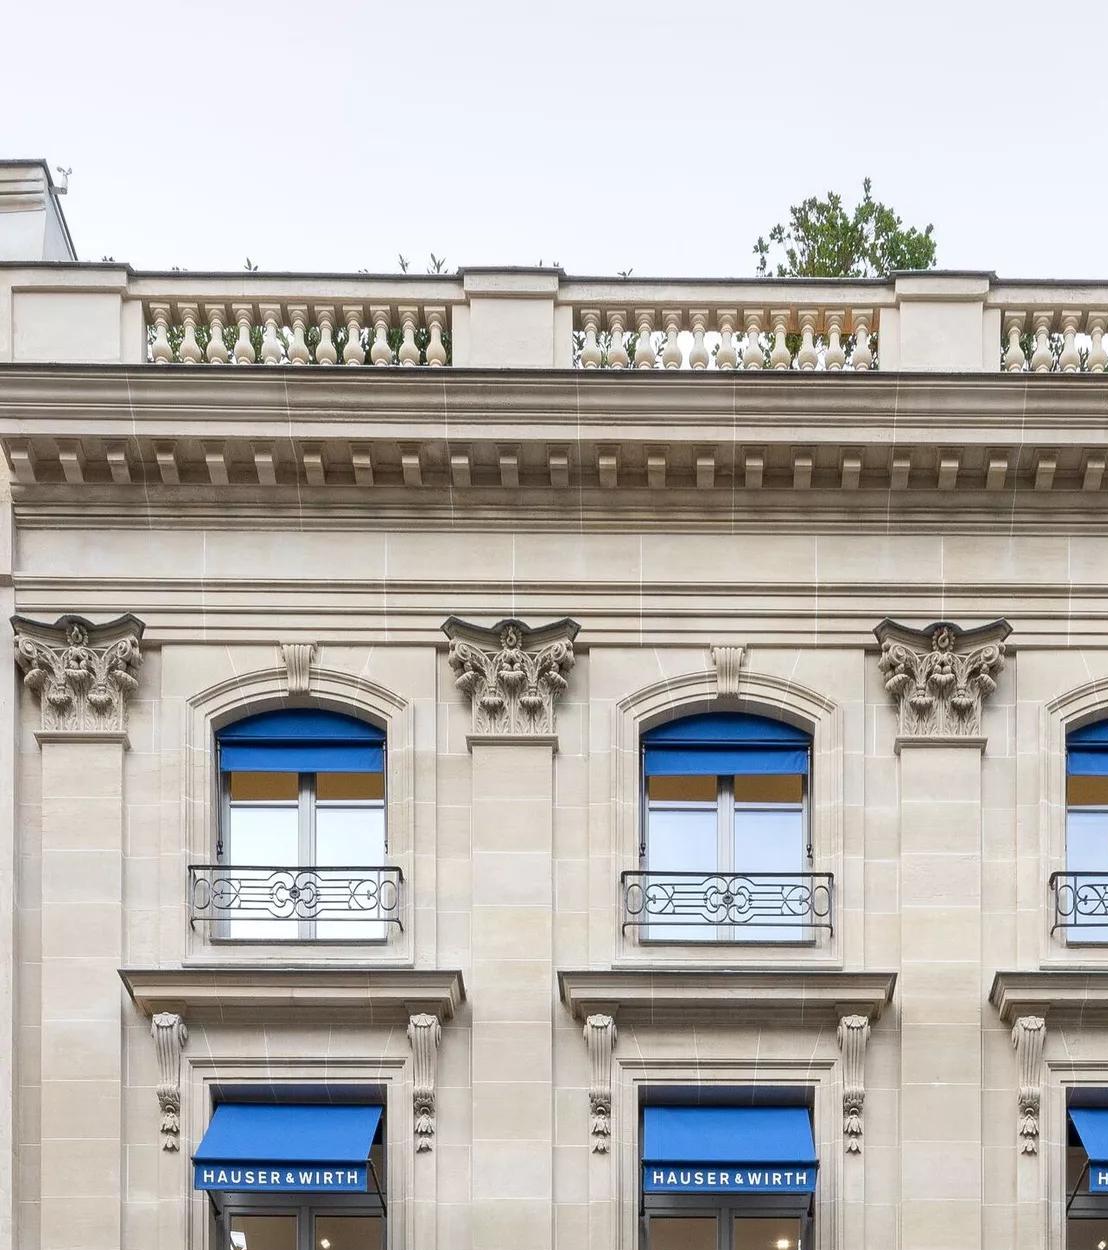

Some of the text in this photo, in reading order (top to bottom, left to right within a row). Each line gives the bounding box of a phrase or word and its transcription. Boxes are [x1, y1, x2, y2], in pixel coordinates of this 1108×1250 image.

[203, 1169, 358, 1185] HAUSER & WIRTH
[653, 1170, 807, 1185] HAUSER & WIRTH
